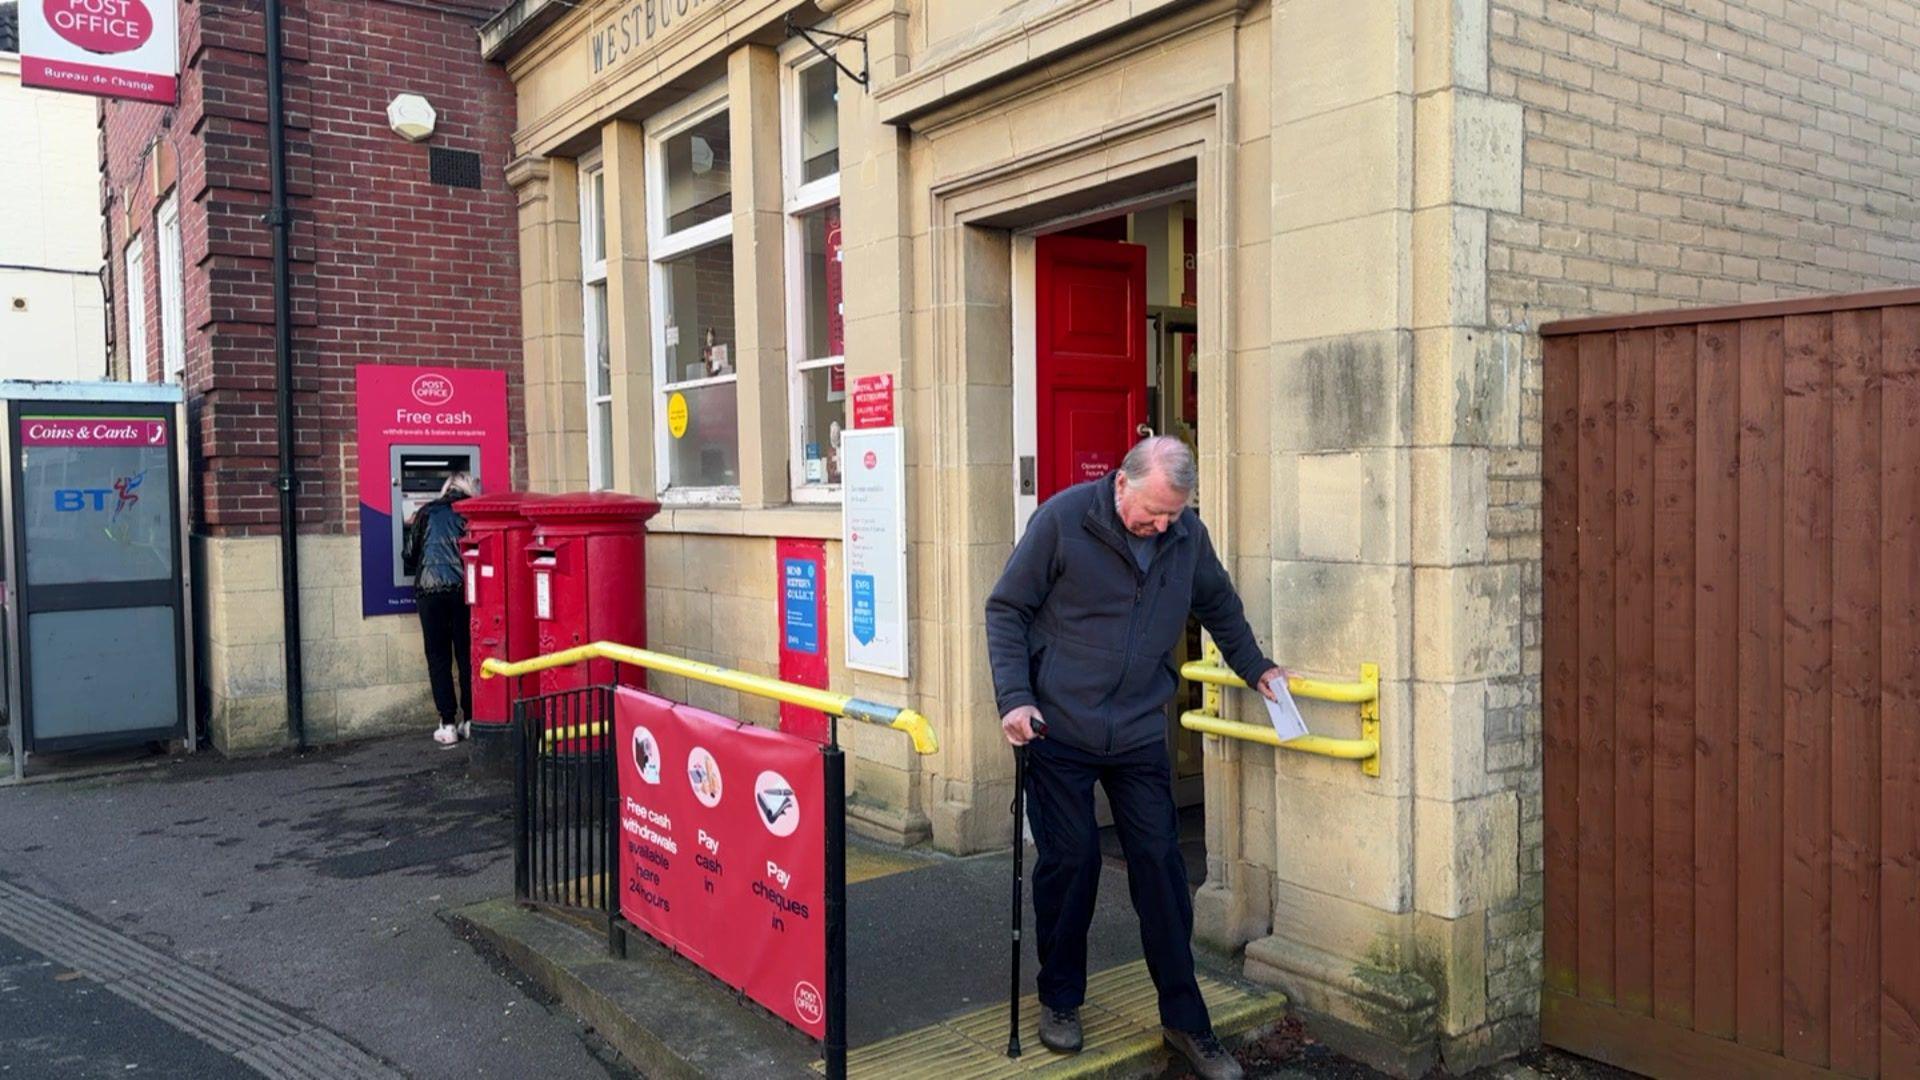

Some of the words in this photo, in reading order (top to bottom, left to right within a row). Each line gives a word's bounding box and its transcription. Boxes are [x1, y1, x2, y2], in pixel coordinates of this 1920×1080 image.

[55, 11, 140, 39] OFFICE
[44, 67, 88, 82] Bureau
[93, 74, 107, 84] de
[111, 76, 154, 91] Change
[416, 388, 448, 397] OFFICE
[421, 380, 445, 389] POST
[396, 408, 432, 424] Free
[435, 410, 472, 424] cash
[29, 424, 75, 440] Coins
[76, 426, 90, 440] &
[93, 424, 138, 440] Cards
[383, 428, 423, 437] withdrawals
[431, 429, 456, 437] balance
[457, 430, 486, 438] enquiries
[1081, 462, 1109, 471] Opening
[54, 487, 113, 512] BT
[626, 796, 648, 820] Free
[648, 810, 672, 831] cash
[622, 817, 678, 855] withdrawals
[698, 829, 719, 855] Pay
[628, 841, 670, 870] available
[695, 853, 723, 876] cash
[635, 862, 660, 886] here
[703, 876, 715, 894] in
[767, 860, 791, 890] Pay
[629, 877, 670, 912] 24hours
[752, 880, 809, 919] cheques
[771, 912, 785, 932] in
[796, 996, 819, 1016] OFFICE
[800, 988, 817, 1004] POST
